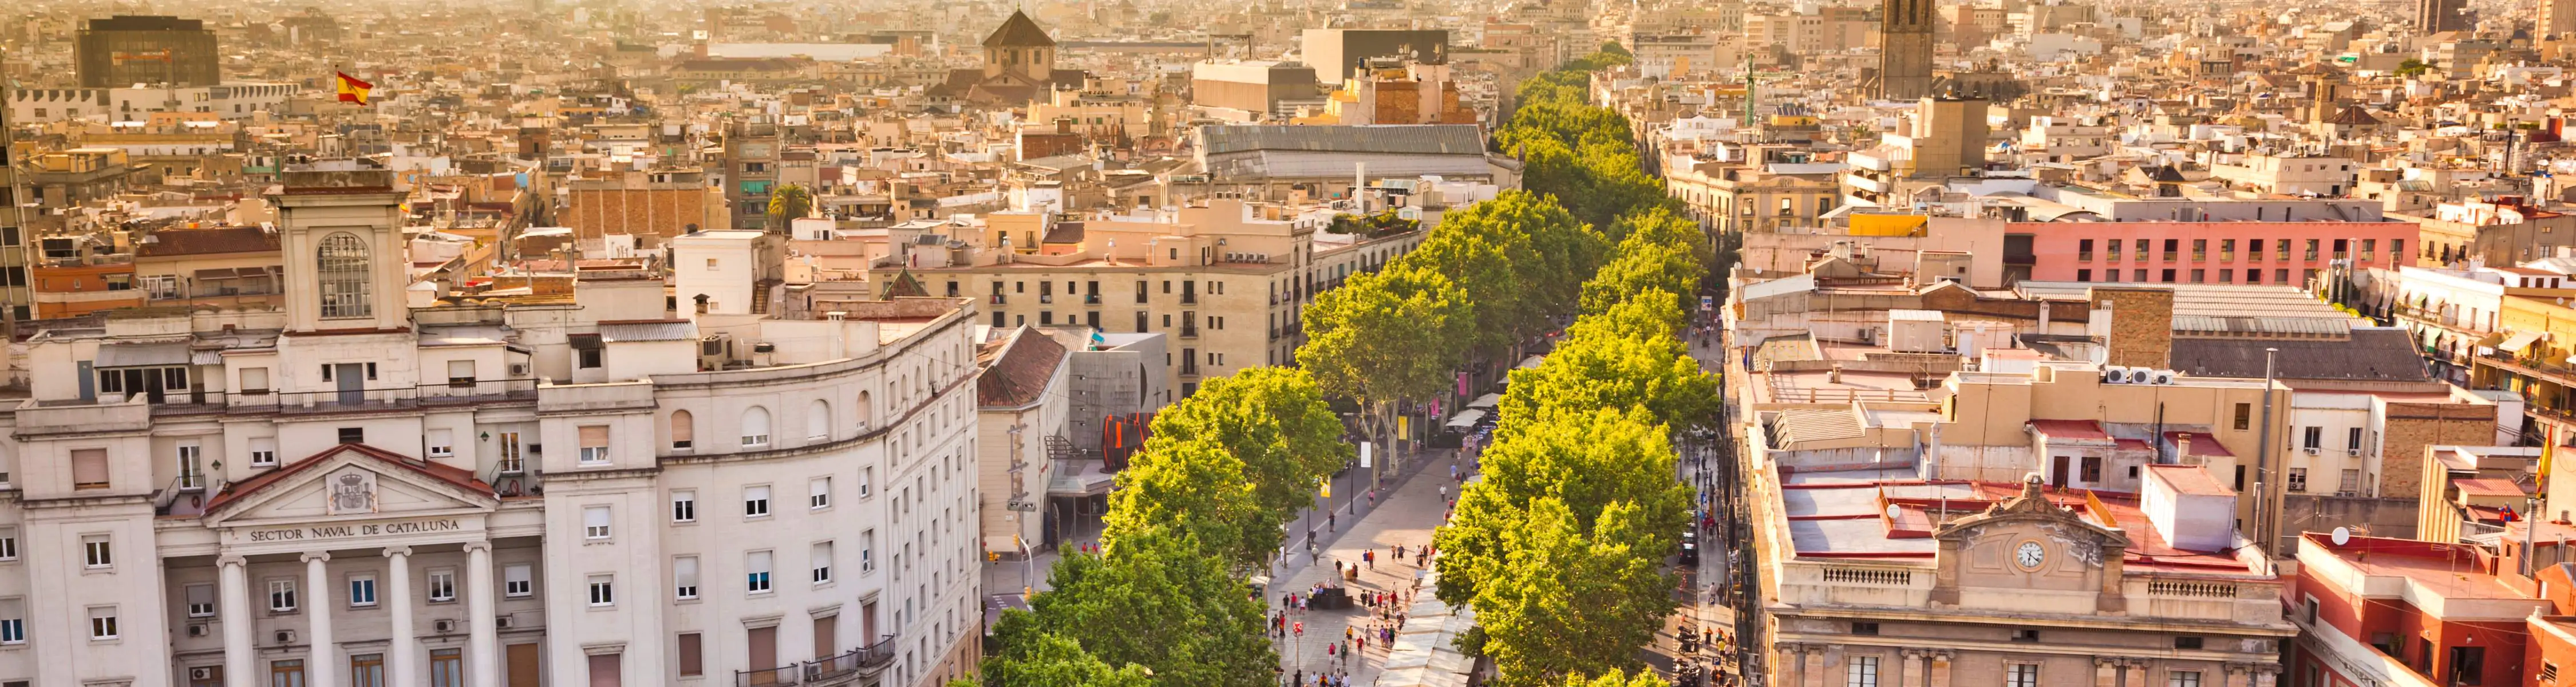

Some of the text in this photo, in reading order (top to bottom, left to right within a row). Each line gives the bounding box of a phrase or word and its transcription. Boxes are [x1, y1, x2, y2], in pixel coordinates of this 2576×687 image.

[251, 520, 460, 542] SECTOR NAVAL DE CATALUÑA
